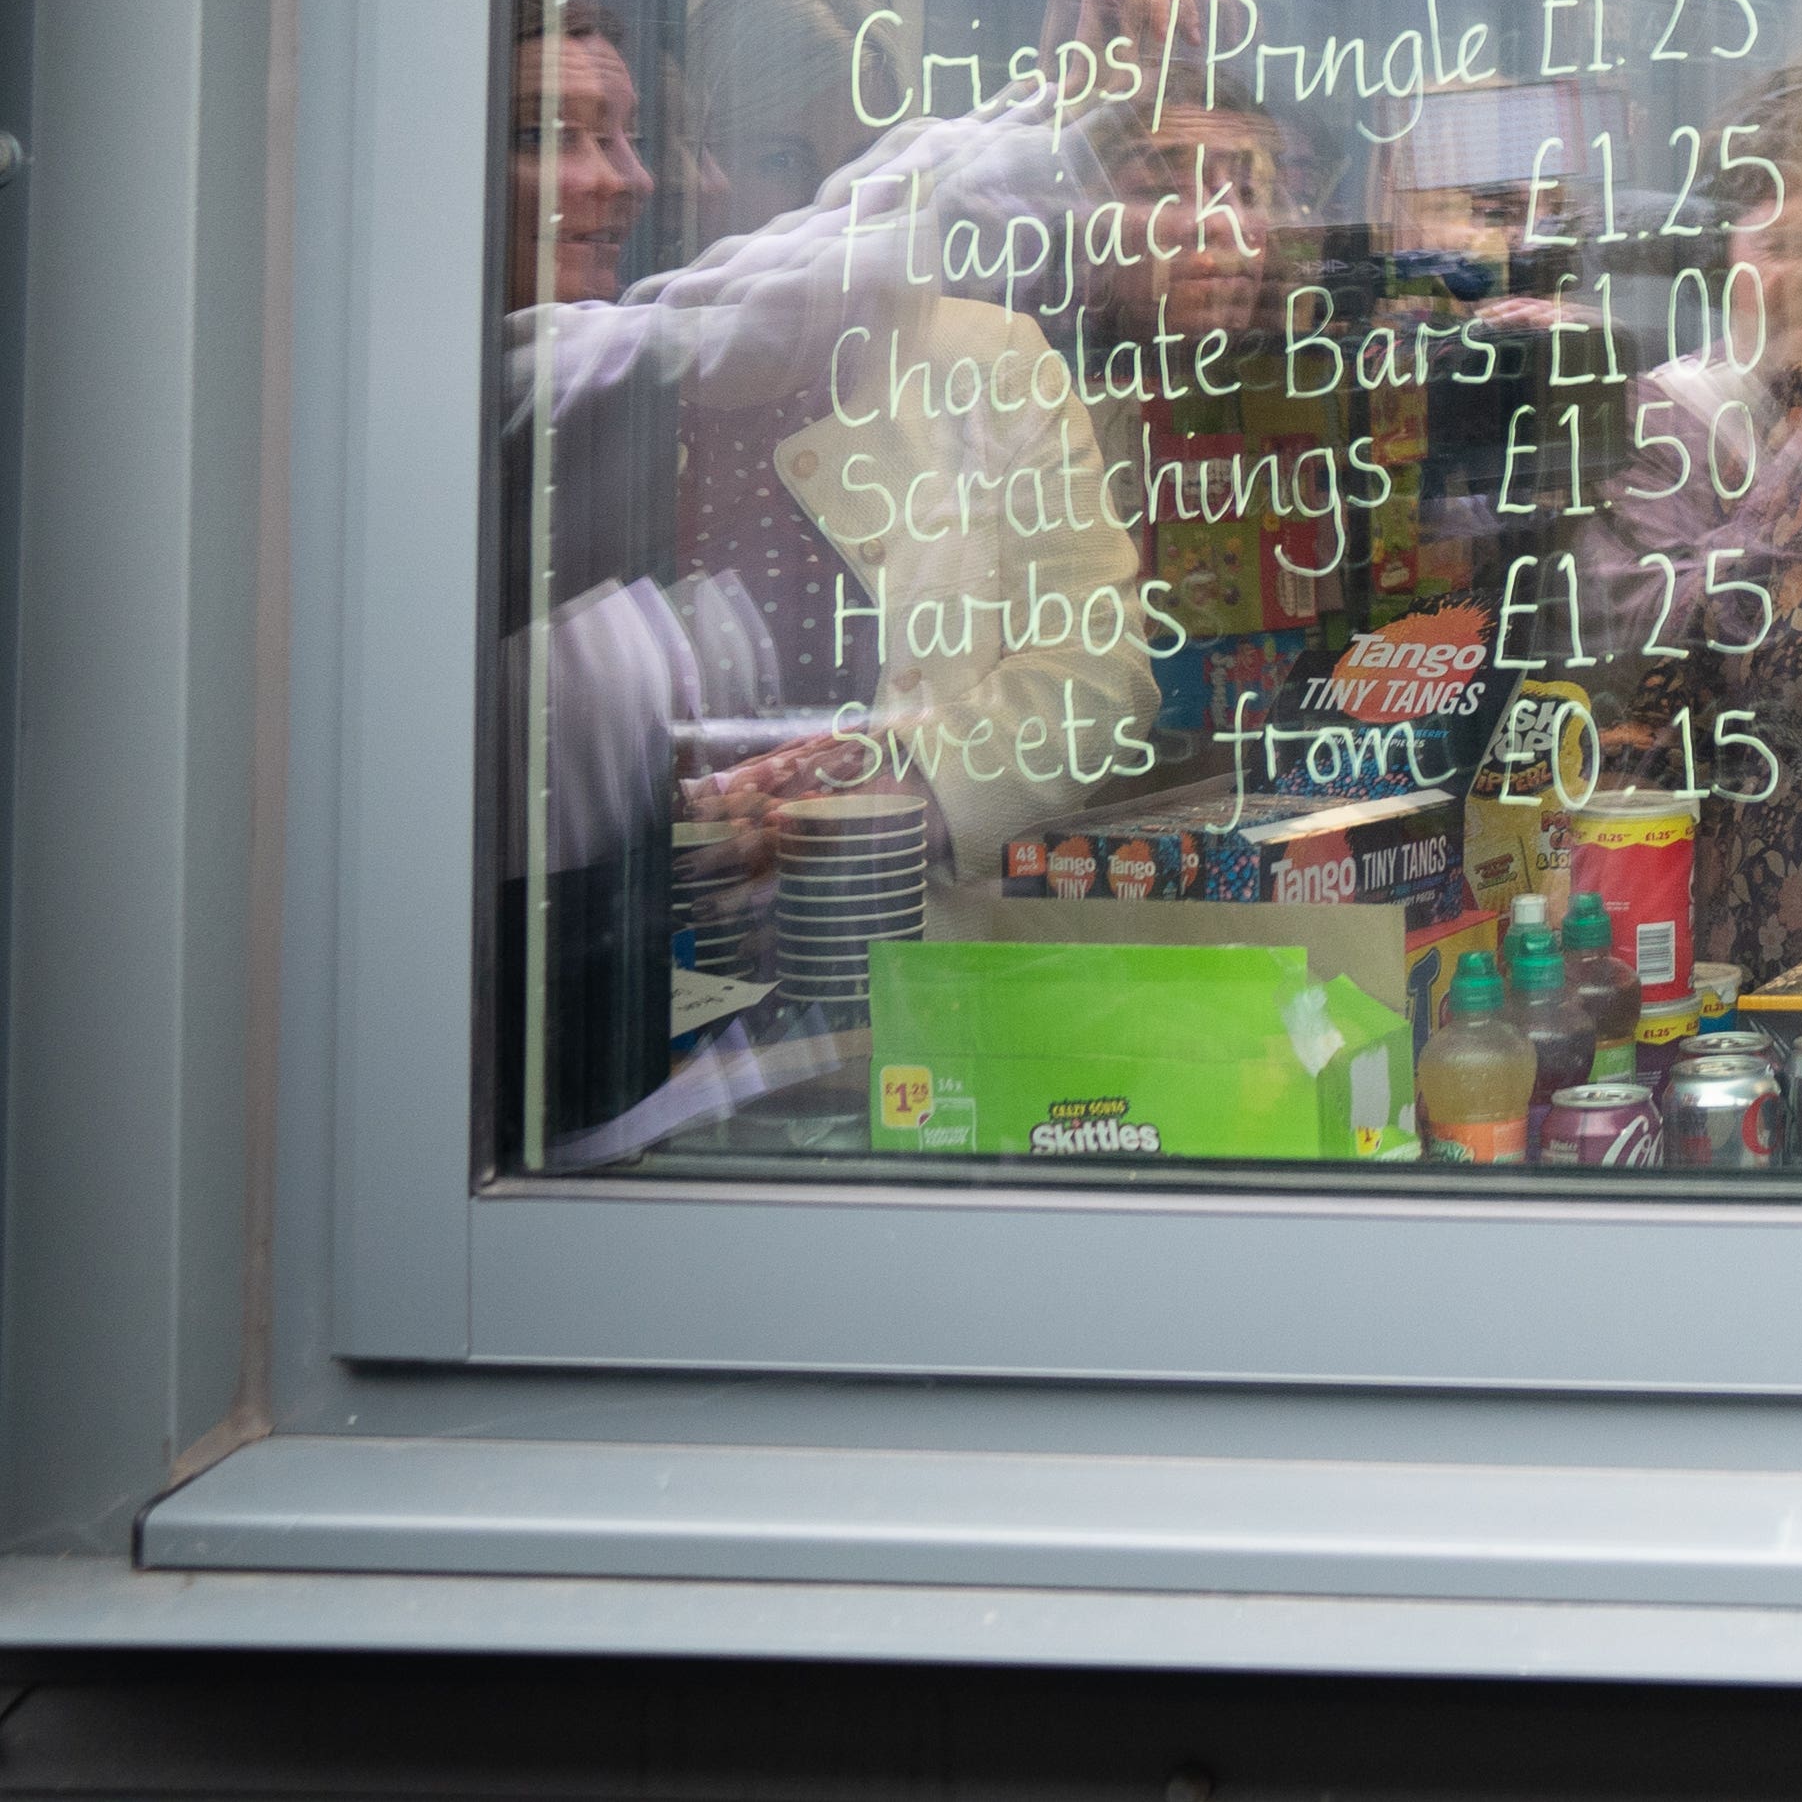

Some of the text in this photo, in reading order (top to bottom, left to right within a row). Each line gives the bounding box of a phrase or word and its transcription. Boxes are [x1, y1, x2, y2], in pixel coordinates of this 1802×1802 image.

[842, 125, 1785, 325] Flapjack £1.25
[829, 293, 1243, 428] Chocolate
[1285, 286, 1497, 399] Bars
[818, 400, 1758, 579] Scratchings £1.50
[833, 548, 1773, 670] Haribos £1.25
[1347, 634, 1487, 678] Tango
[1299, 676, 1487, 716] TINY TANGS
[814, 679, 1780, 834] Sweets from £0.15
[1016, 844, 1037, 861] 48
[1047, 853, 1096, 877] Tango
[1108, 855, 1156, 879] Tango
[1270, 857, 1356, 903] Tango
[1362, 846, 1397, 892] TINY
[1401, 835, 1447, 881] TANGS
[1056, 878, 1087, 899] TINY
[1116, 882, 1147, 900] TINY
[1031, 1119, 1160, 1155] Skittles
